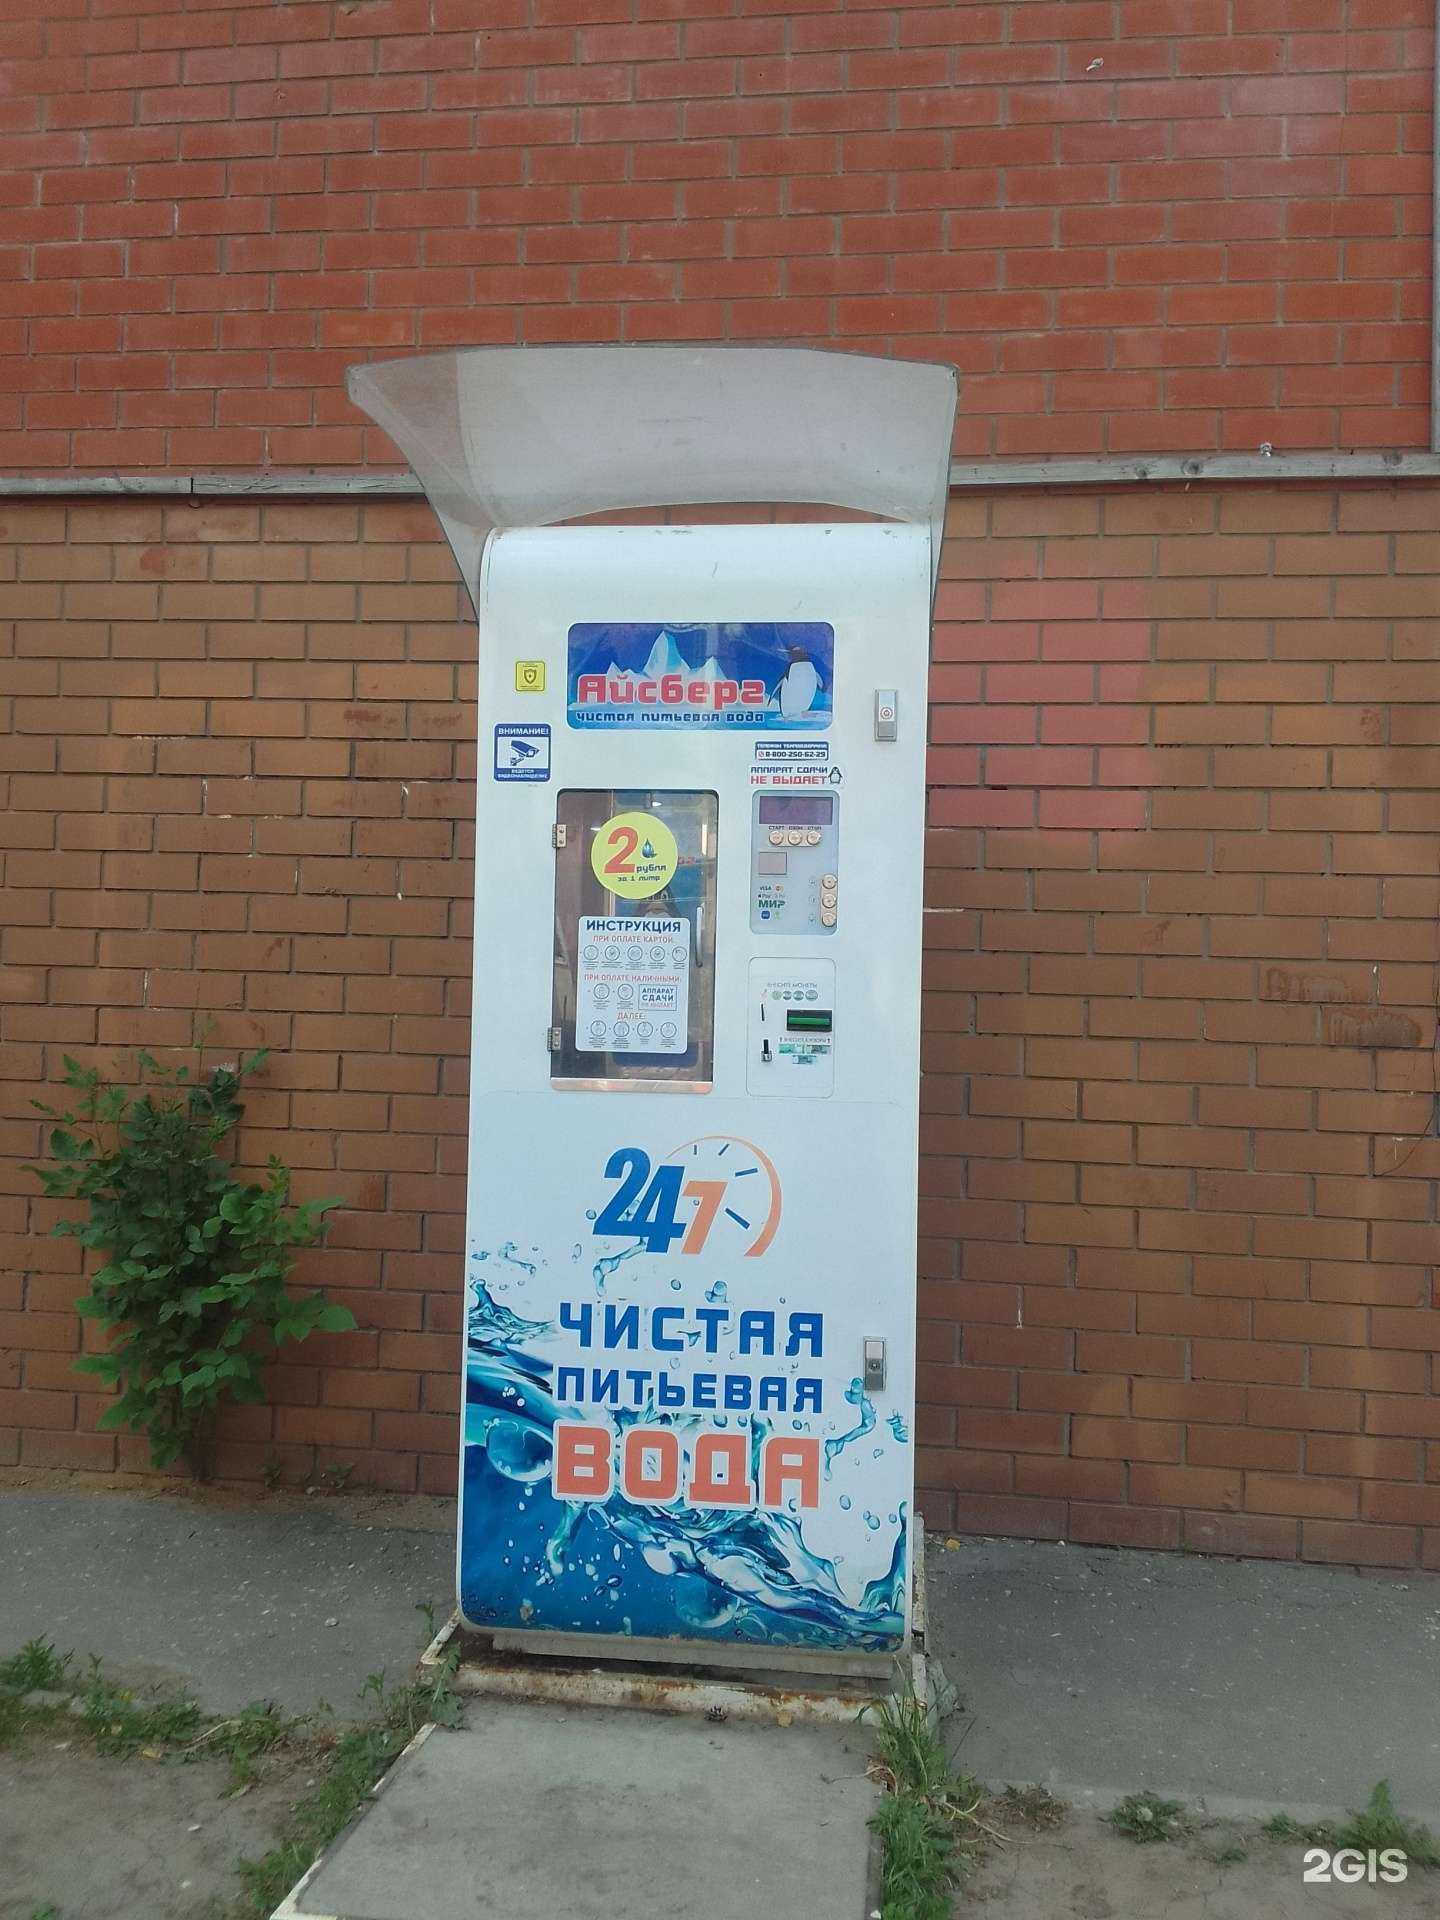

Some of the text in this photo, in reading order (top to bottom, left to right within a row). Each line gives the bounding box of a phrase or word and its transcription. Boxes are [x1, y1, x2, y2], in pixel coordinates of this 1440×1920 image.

[579, 674, 765, 710] Айсберг
[577, 711, 764, 722] чистая питьевая вода
[498, 727, 549, 735] ВНИМАНИЕ!
[750, 766, 828, 774] АППАРАТ СДАЧИ
[750, 775, 828, 785] НЕ ВЫДАЕТ
[603, 826, 639, 874] 2
[758, 899, 786, 909] МИР
[586, 919, 681, 934] ИНСТРУКЦИЯ
[593, 935, 609, 943] ПРИ
[641, 994, 674, 1002] СДАЧИ
[559, 1302, 824, 1358] ЧИСТАЯ
[557, 1366, 823, 1414] ПИТЬЕВАЯ
[556, 1425, 821, 1509] ВОДА
